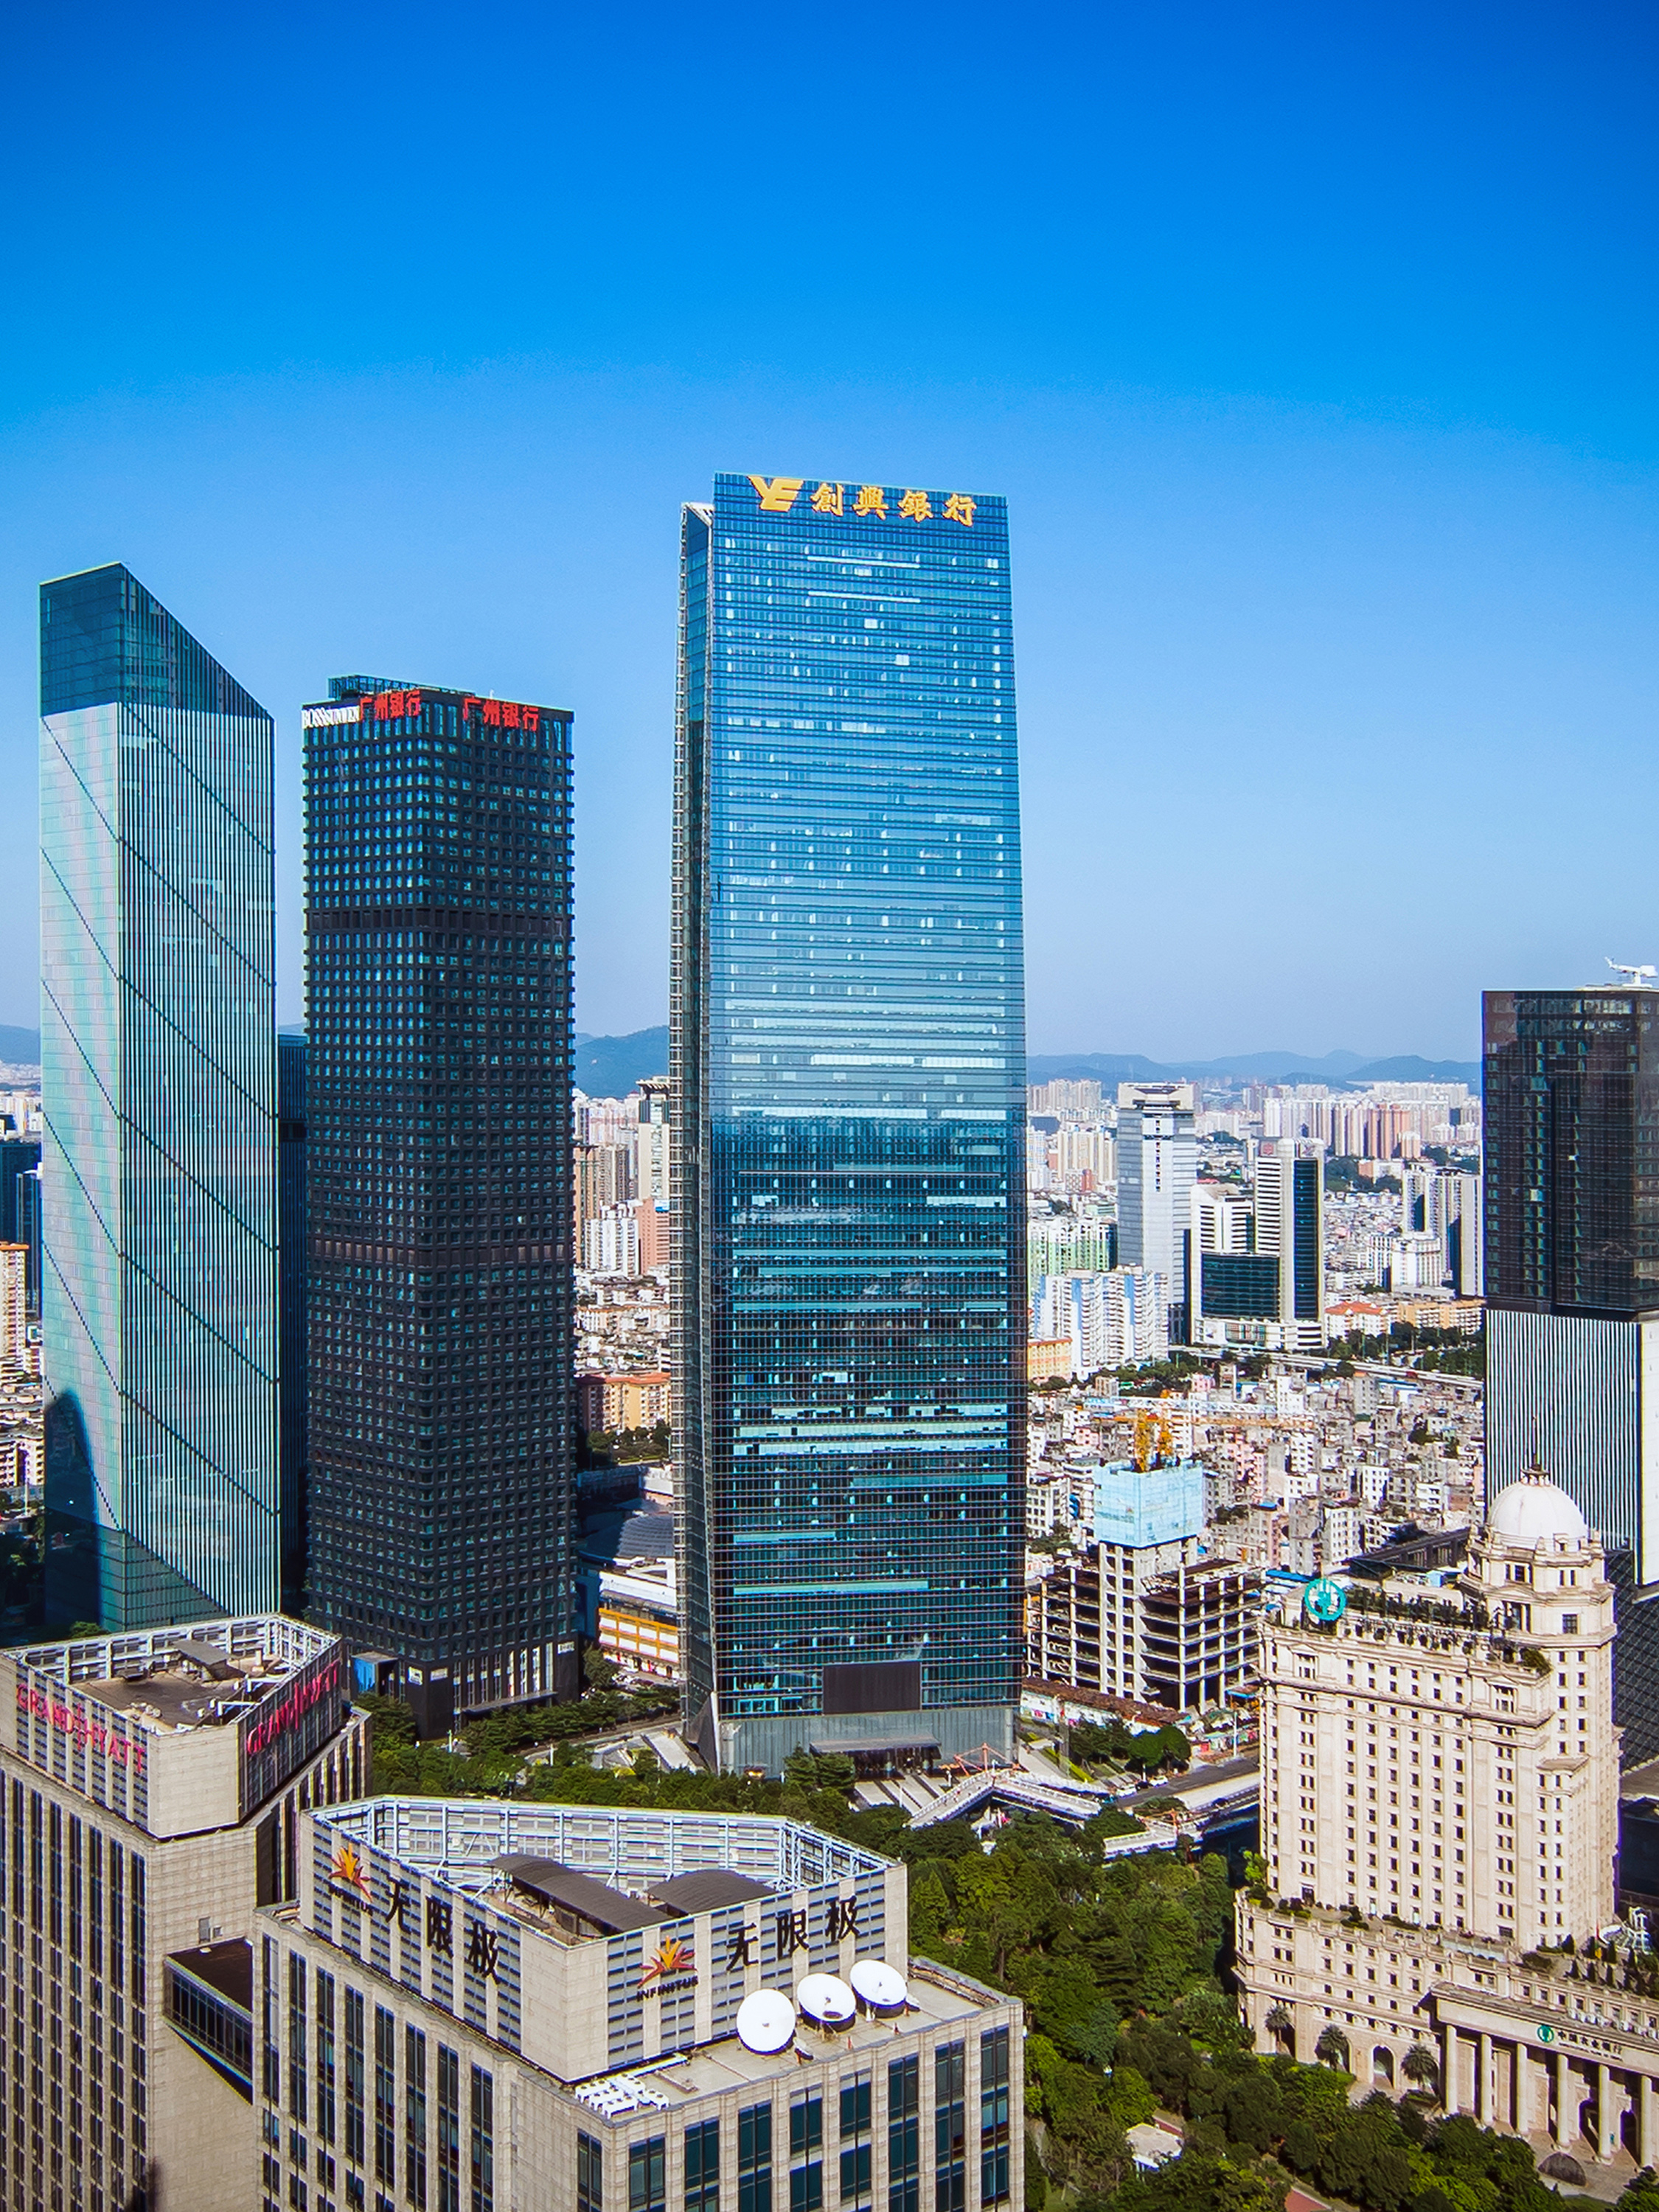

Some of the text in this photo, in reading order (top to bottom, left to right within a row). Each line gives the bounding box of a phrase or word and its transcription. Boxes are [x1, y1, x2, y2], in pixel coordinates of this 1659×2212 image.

[360, 690, 421, 721] 广州银行
[463, 696, 540, 732] 广州银行
[385, 1876, 501, 1985] 无限极
[726, 1895, 860, 1971] 无限极
[636, 1975, 699, 2002] INFINITUS
